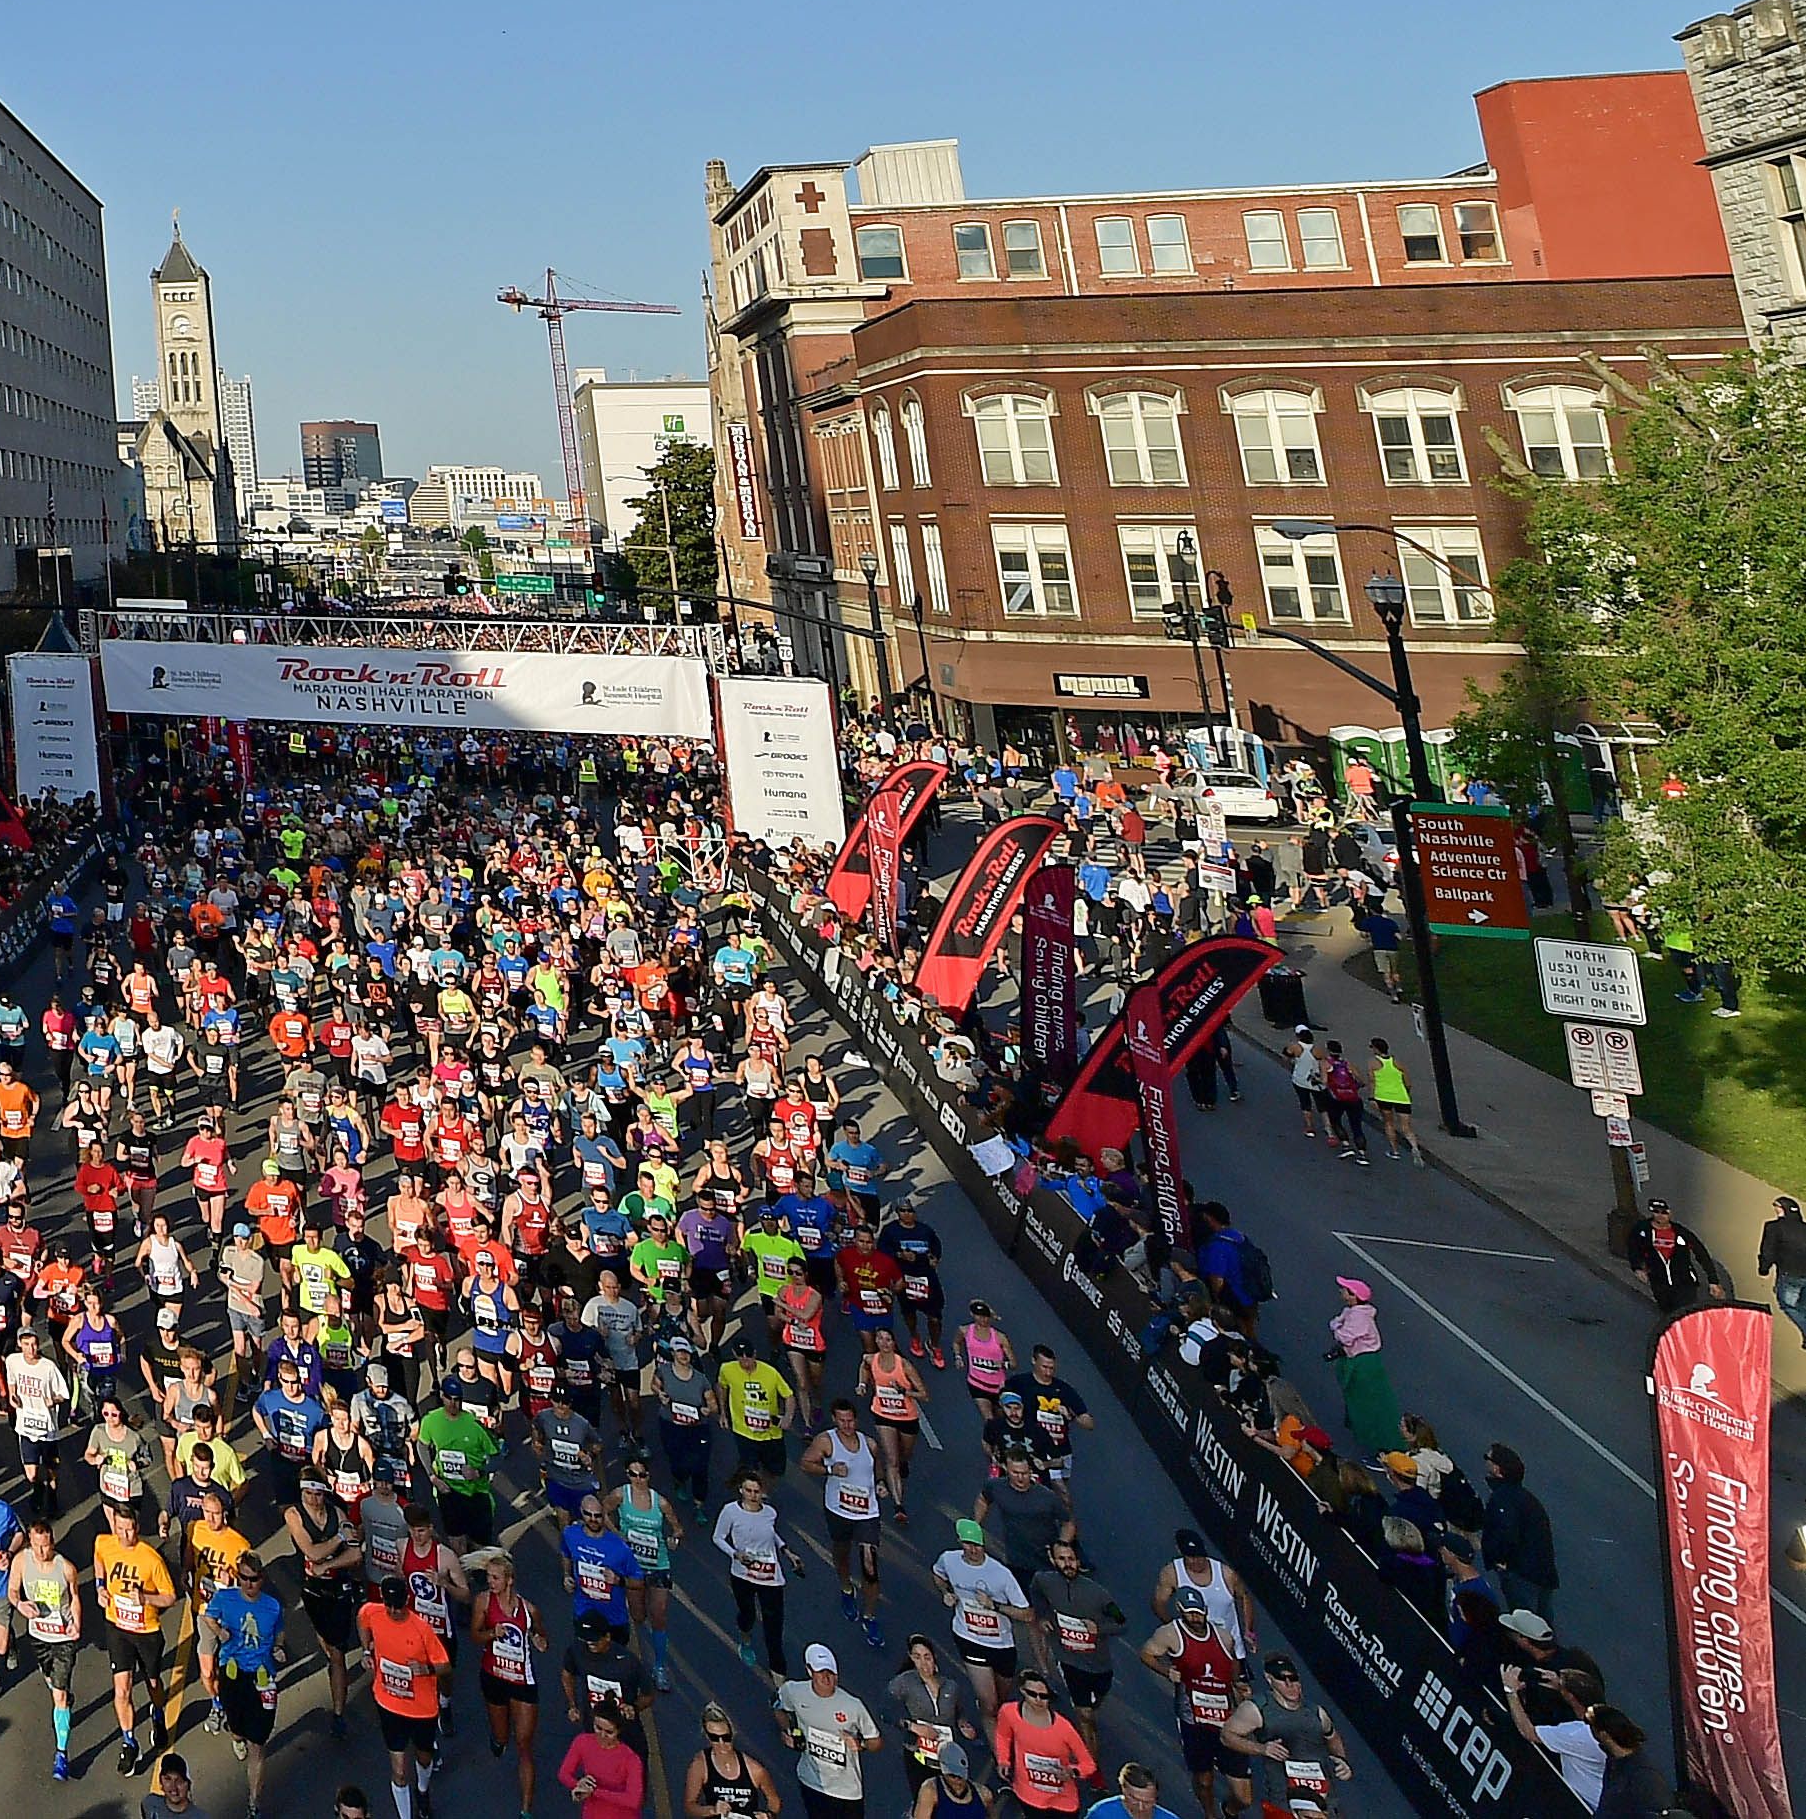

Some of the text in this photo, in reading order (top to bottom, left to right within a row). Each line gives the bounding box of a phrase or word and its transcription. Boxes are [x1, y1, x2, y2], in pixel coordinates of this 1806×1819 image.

[731, 427, 748, 476] MORGAN
[739, 486, 756, 536] MORGAN
[780, 648, 792, 658] 70
[277, 658, 383, 683] Rock
[416, 662, 506, 688] Roll
[293, 683, 494, 701] MARATHON HALF MARATHON
[317, 695, 467, 715] NASHVILLE
[764, 788, 807, 800] Humana
[1418, 819, 1464, 831] South
[1420, 833, 1494, 847] Nashville
[1430, 851, 1501, 865] Adventure
[1432, 866, 1507, 880] Science Ctr
[974, 849, 1028, 937] MARATHON SERIES
[1435, 888, 1494, 902] Ballpark
[1565, 950, 1606, 963] NORTH
[1048, 941, 1068, 999] Finding
[1549, 962, 1628, 980] US31 US41A
[1551, 977, 1630, 995] US41 US431
[1189, 976, 1223, 1015] SERIES
[1553, 993, 1633, 1012] RIGHT ON 8th
[1703, 1416, 1755, 1441] Hospital
[1195, 1409, 1244, 1500] WESTIN
[1257, 1483, 1317, 1587] WESTIN
[1700, 1469, 1747, 1601] Finding
[199, 1547, 228, 1565] ALL
[110, 1562, 140, 1580] ALL
[122, 1581, 144, 1595] IN
[1062, 1628, 1091, 1641] 2407
[1326, 1582, 1359, 1636] Rock
[1370, 1634, 1405, 1688] Roll
[496, 1657, 522, 1671] 11184
[1323, 1615, 1392, 1700] MARATHON SERIES
[1443, 1705, 1513, 1803] cep
